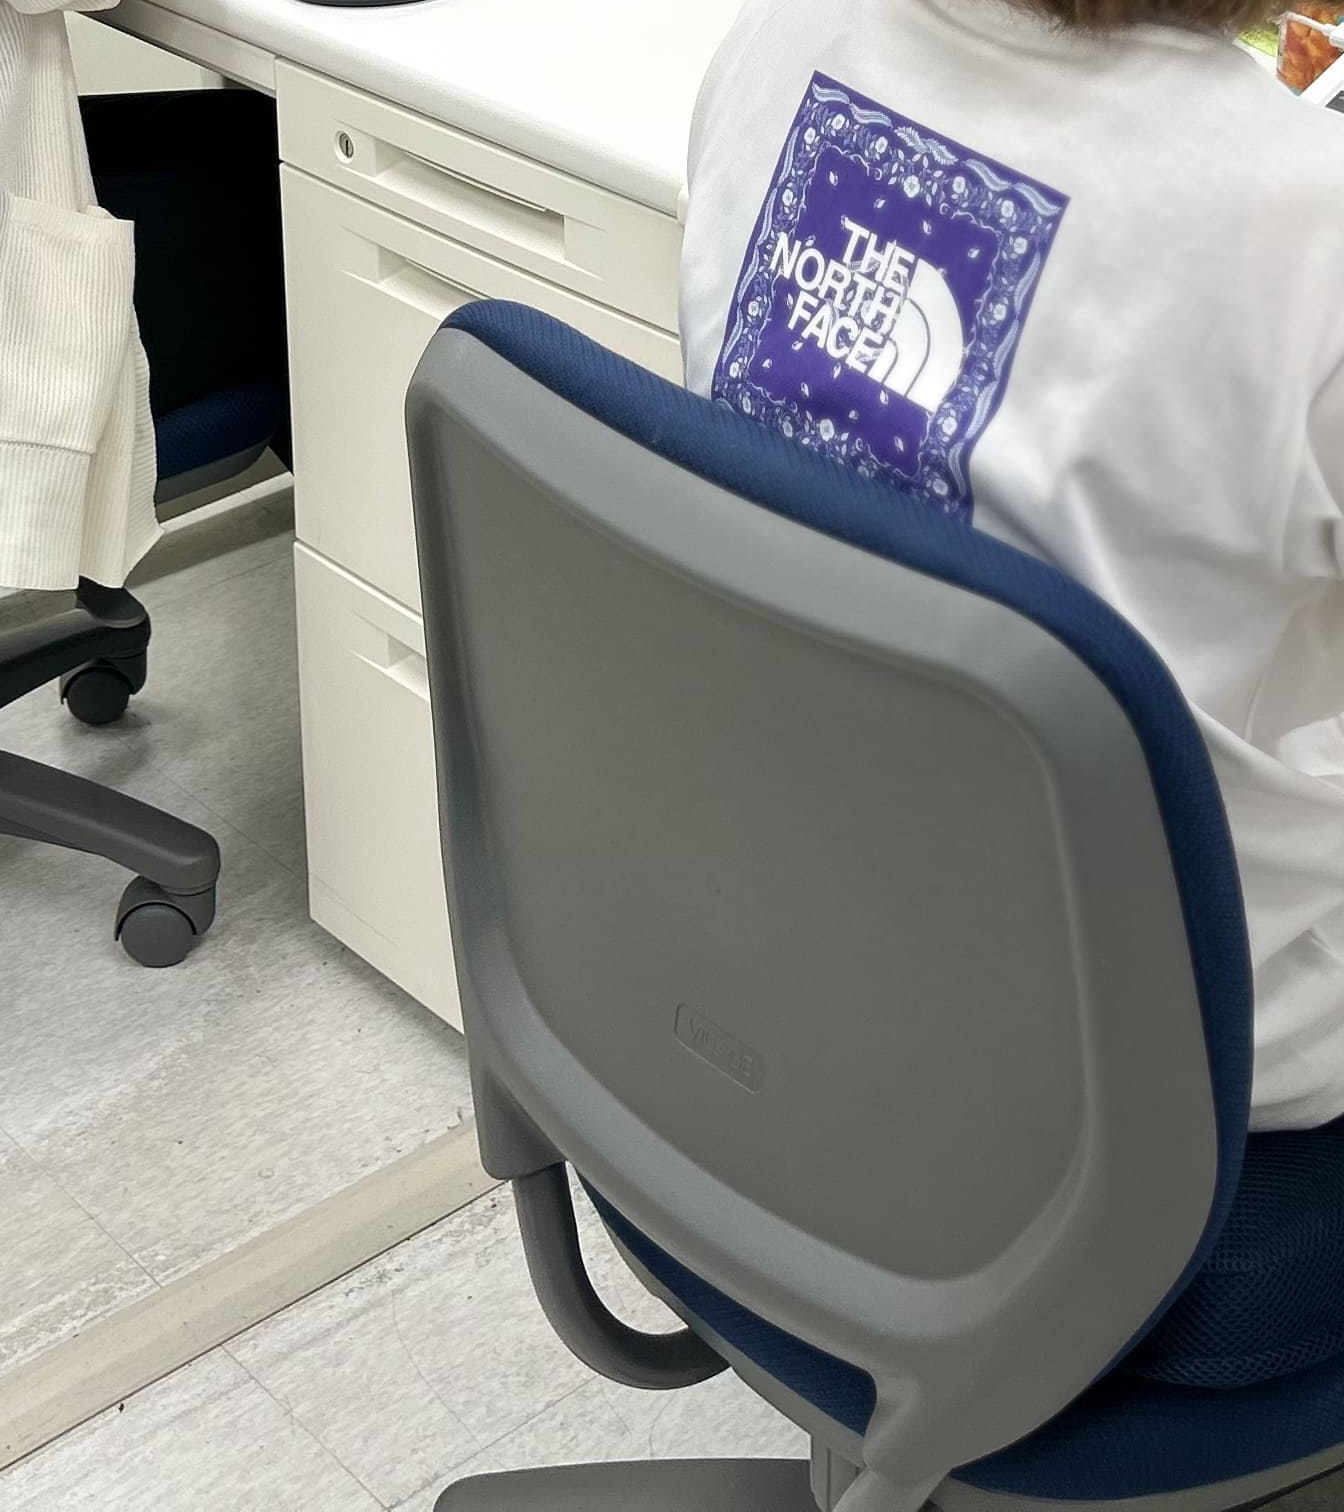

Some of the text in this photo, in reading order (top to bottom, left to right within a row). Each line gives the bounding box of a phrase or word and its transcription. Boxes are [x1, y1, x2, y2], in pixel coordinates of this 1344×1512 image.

[769, 231, 906, 333] NORTH
[841, 216, 915, 287] THE
[787, 290, 886, 374] FACE
